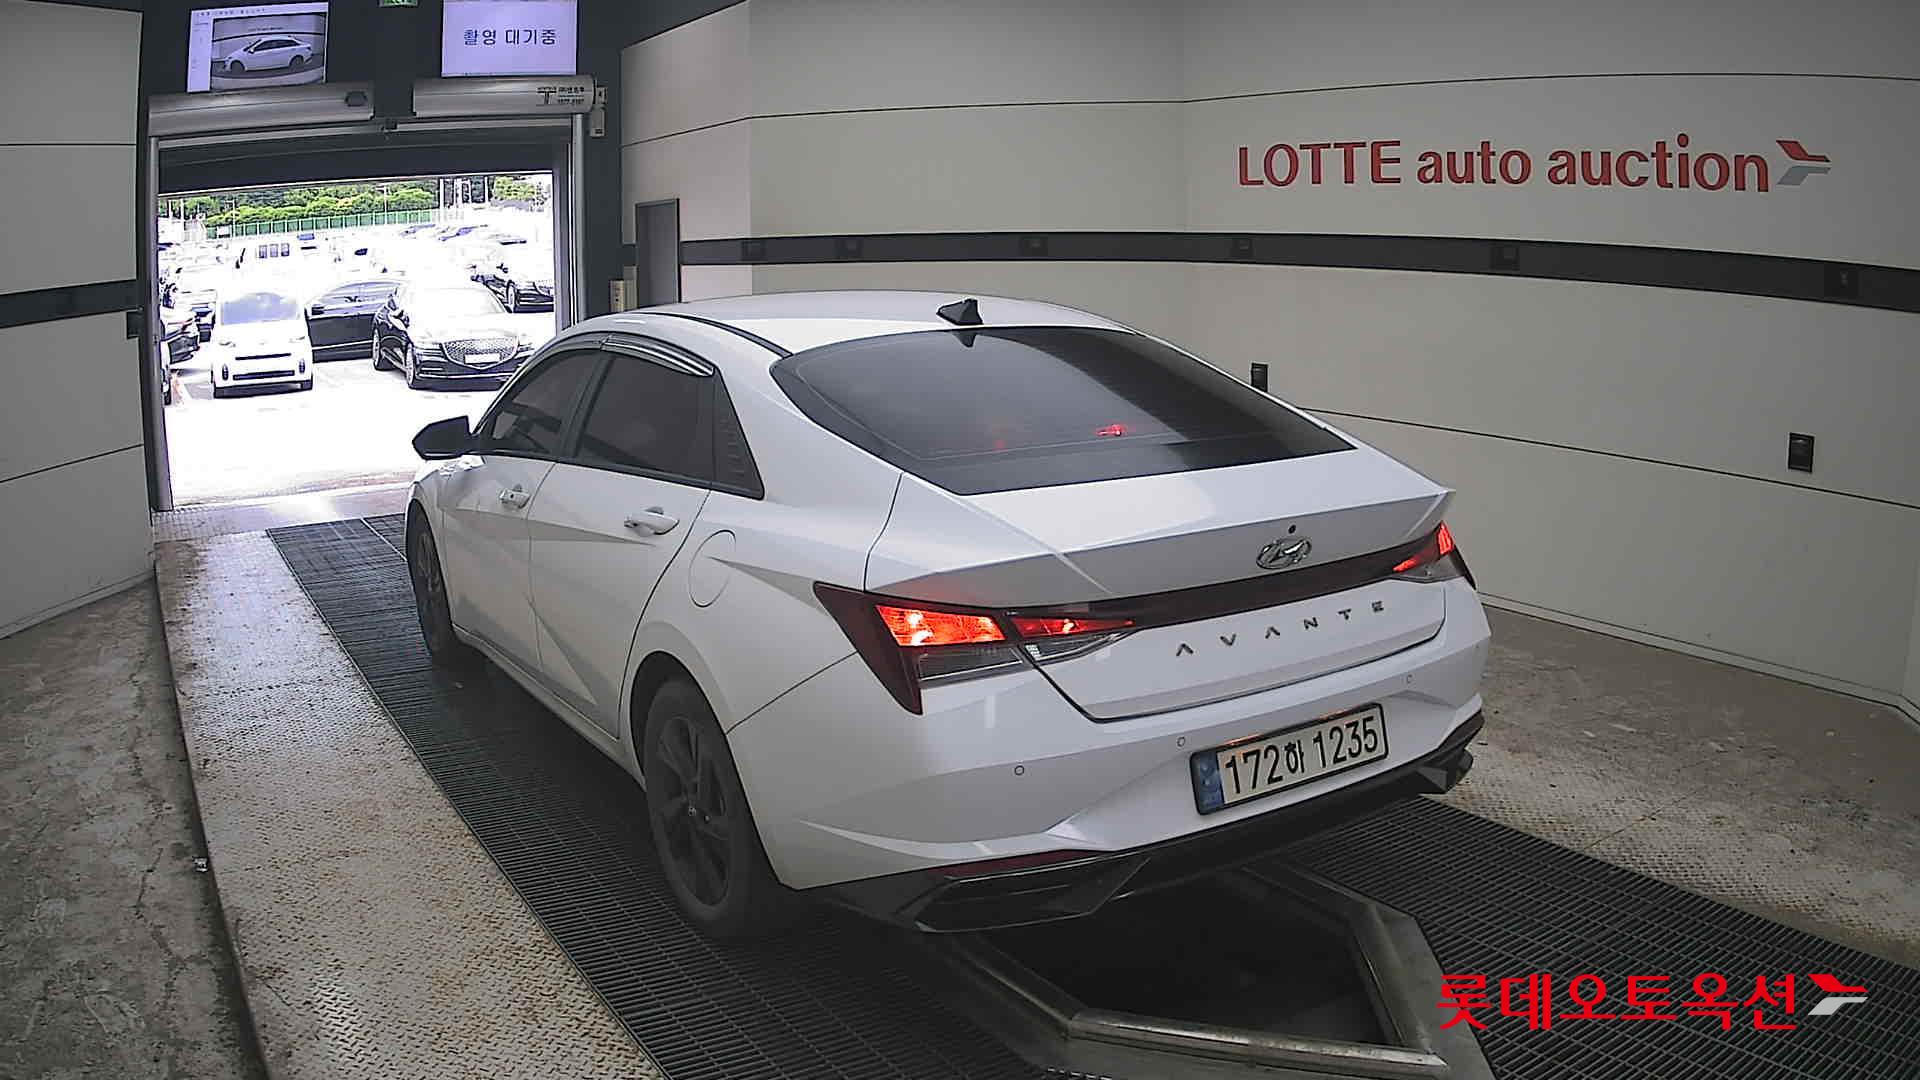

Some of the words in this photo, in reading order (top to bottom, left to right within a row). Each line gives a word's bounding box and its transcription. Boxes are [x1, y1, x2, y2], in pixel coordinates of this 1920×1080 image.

[463, 29, 497, 46] 촬영
[505, 28, 557, 46] 대기중
[1238, 140, 1401, 187] LOTTE
[1416, 140, 1531, 186] auto
[1547, 133, 1769, 193] auction
[1175, 600, 1385, 657] AVANTE
[1225, 740, 1305, 794] 172하
[1312, 715, 1378, 769] 1235
